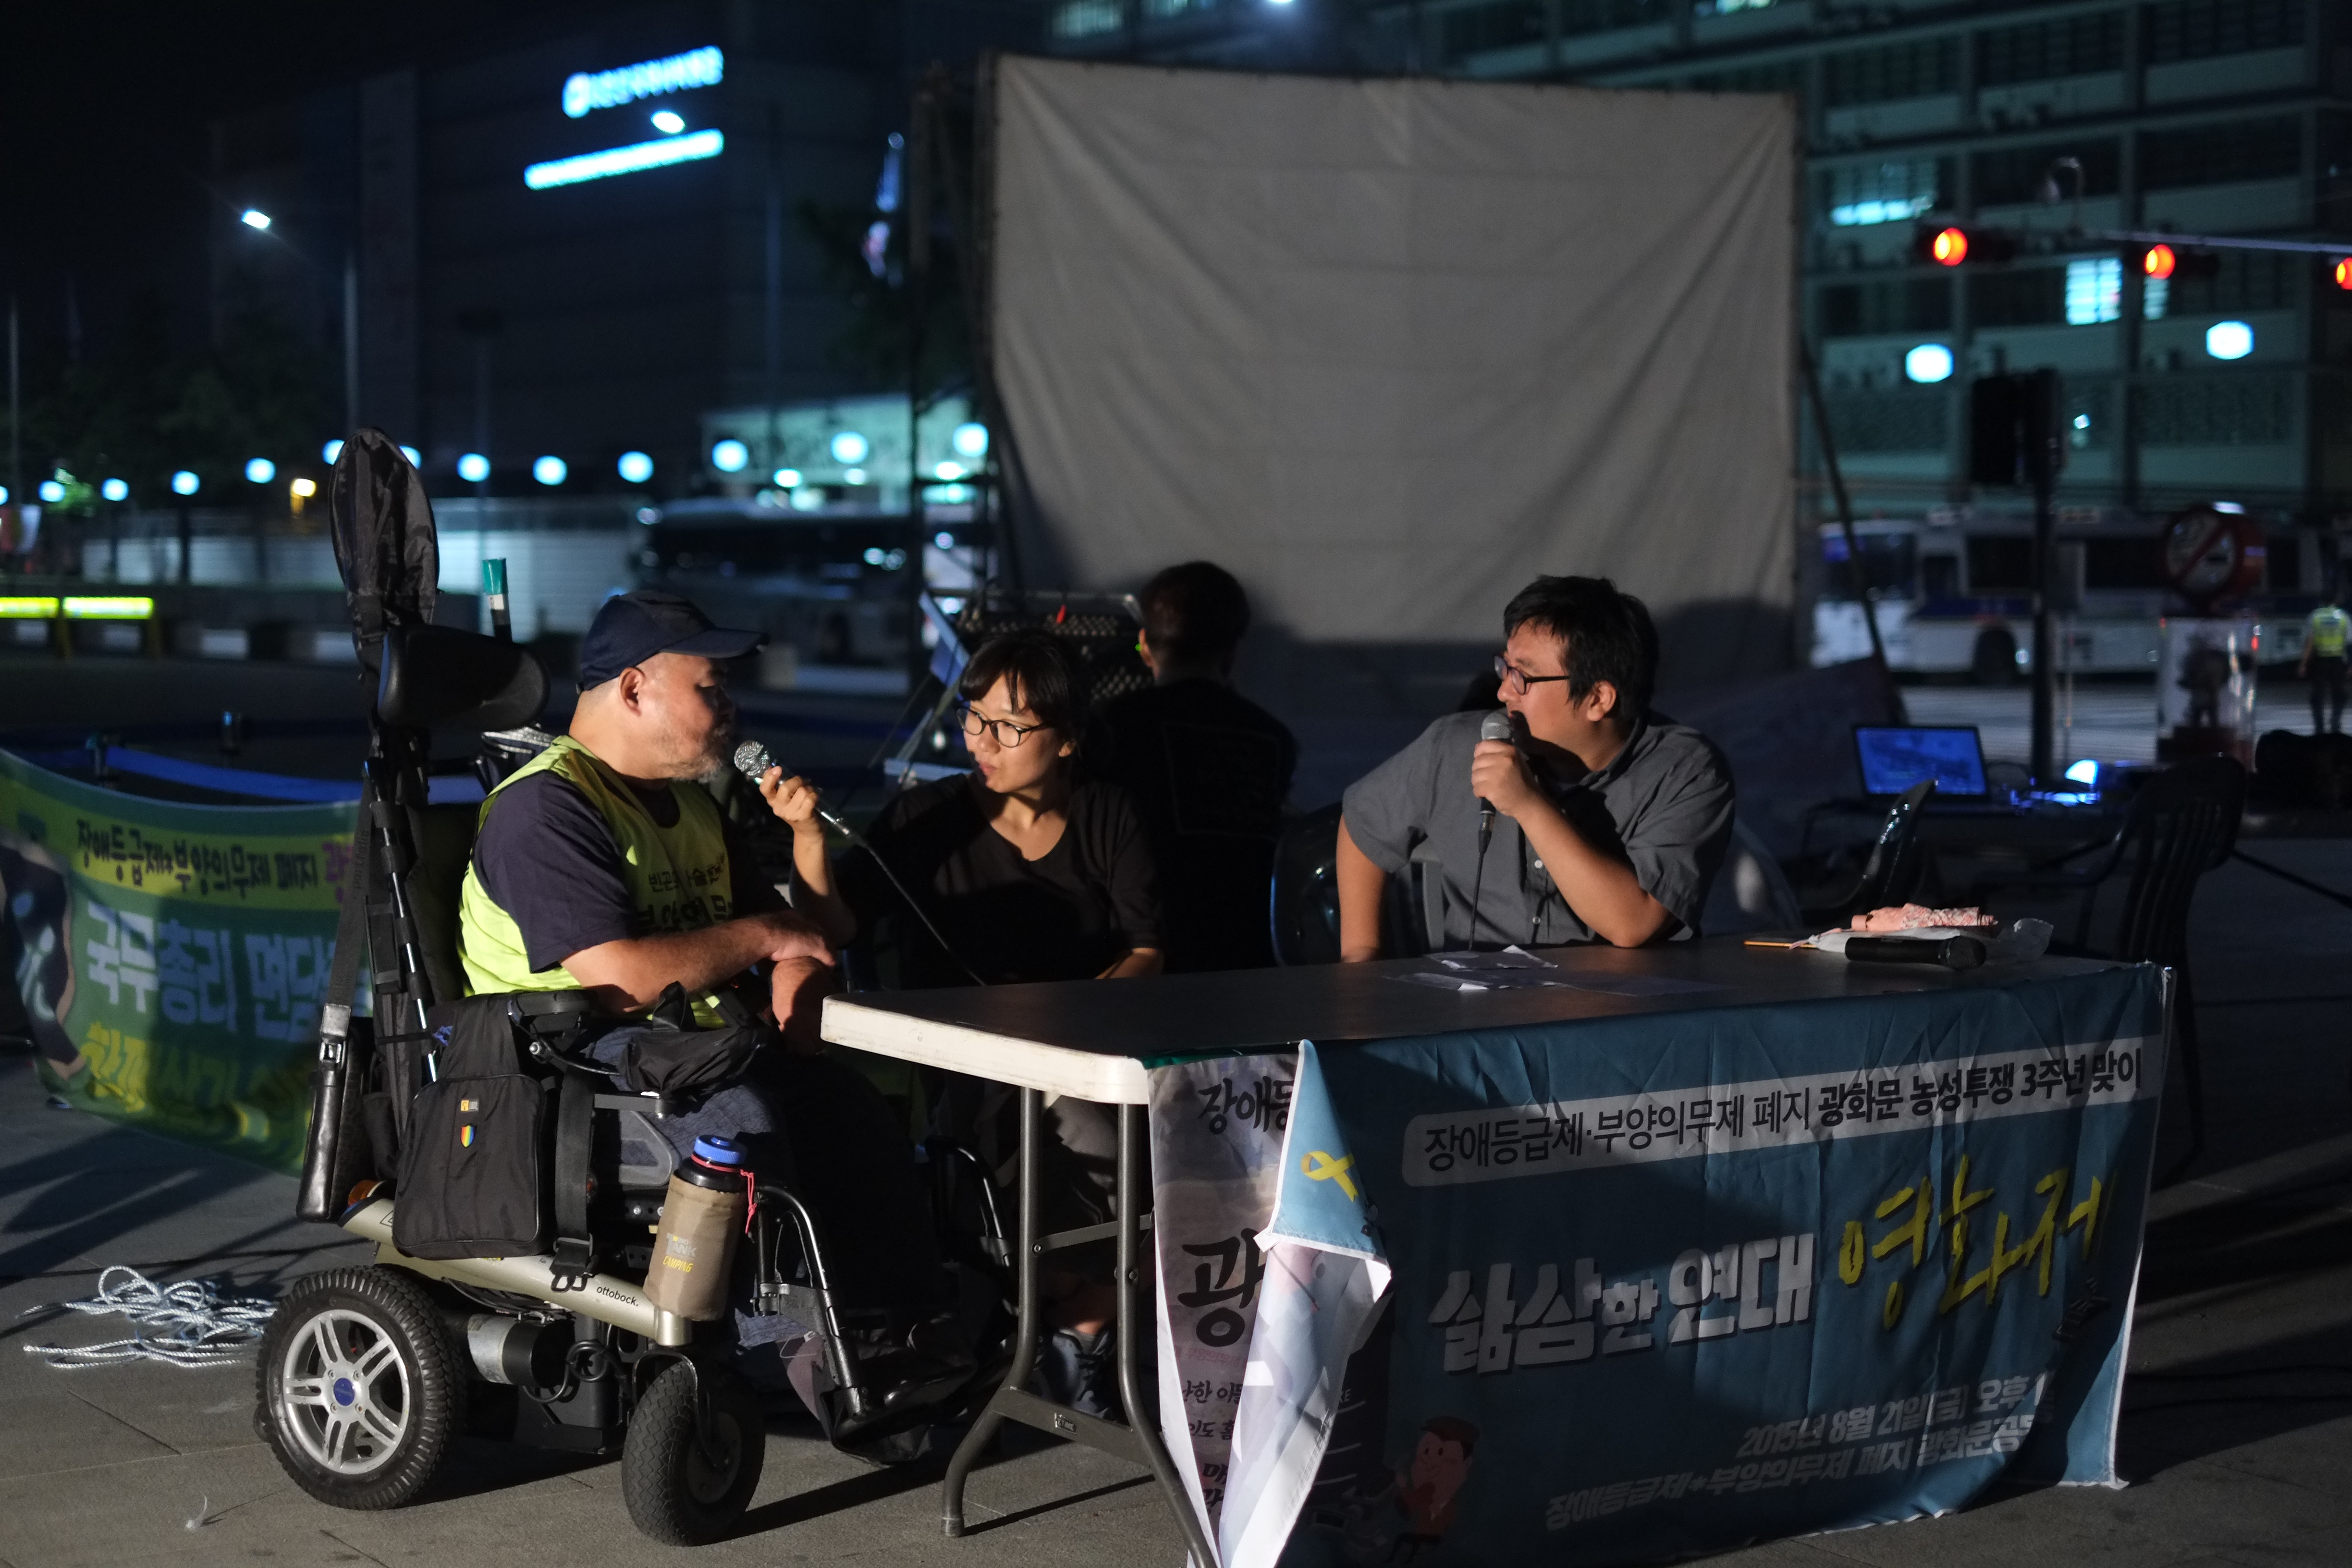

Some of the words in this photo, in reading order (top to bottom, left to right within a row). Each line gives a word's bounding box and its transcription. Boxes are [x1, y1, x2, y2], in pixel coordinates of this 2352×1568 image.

[1424, 1094, 1744, 1171] 장애등급제·부양의무제
[1752, 1087, 1809, 1133] 폐지
[1818, 1079, 1904, 1127] 광화문
[1910, 1063, 2015, 1116] 농성투쟁
[2021, 1054, 2086, 1099] 3주년
[2092, 1048, 2142, 1093] 맞이
[662, 1255, 694, 1273] CAMPING
[1668, 1233, 1814, 1343] 연대
[1736, 1413, 1826, 1458] 2015년
[1828, 1405, 1875, 1445] 8월
[1973, 1375, 2030, 1413] 오후
[1855, 1437, 1914, 1474] 폐지
